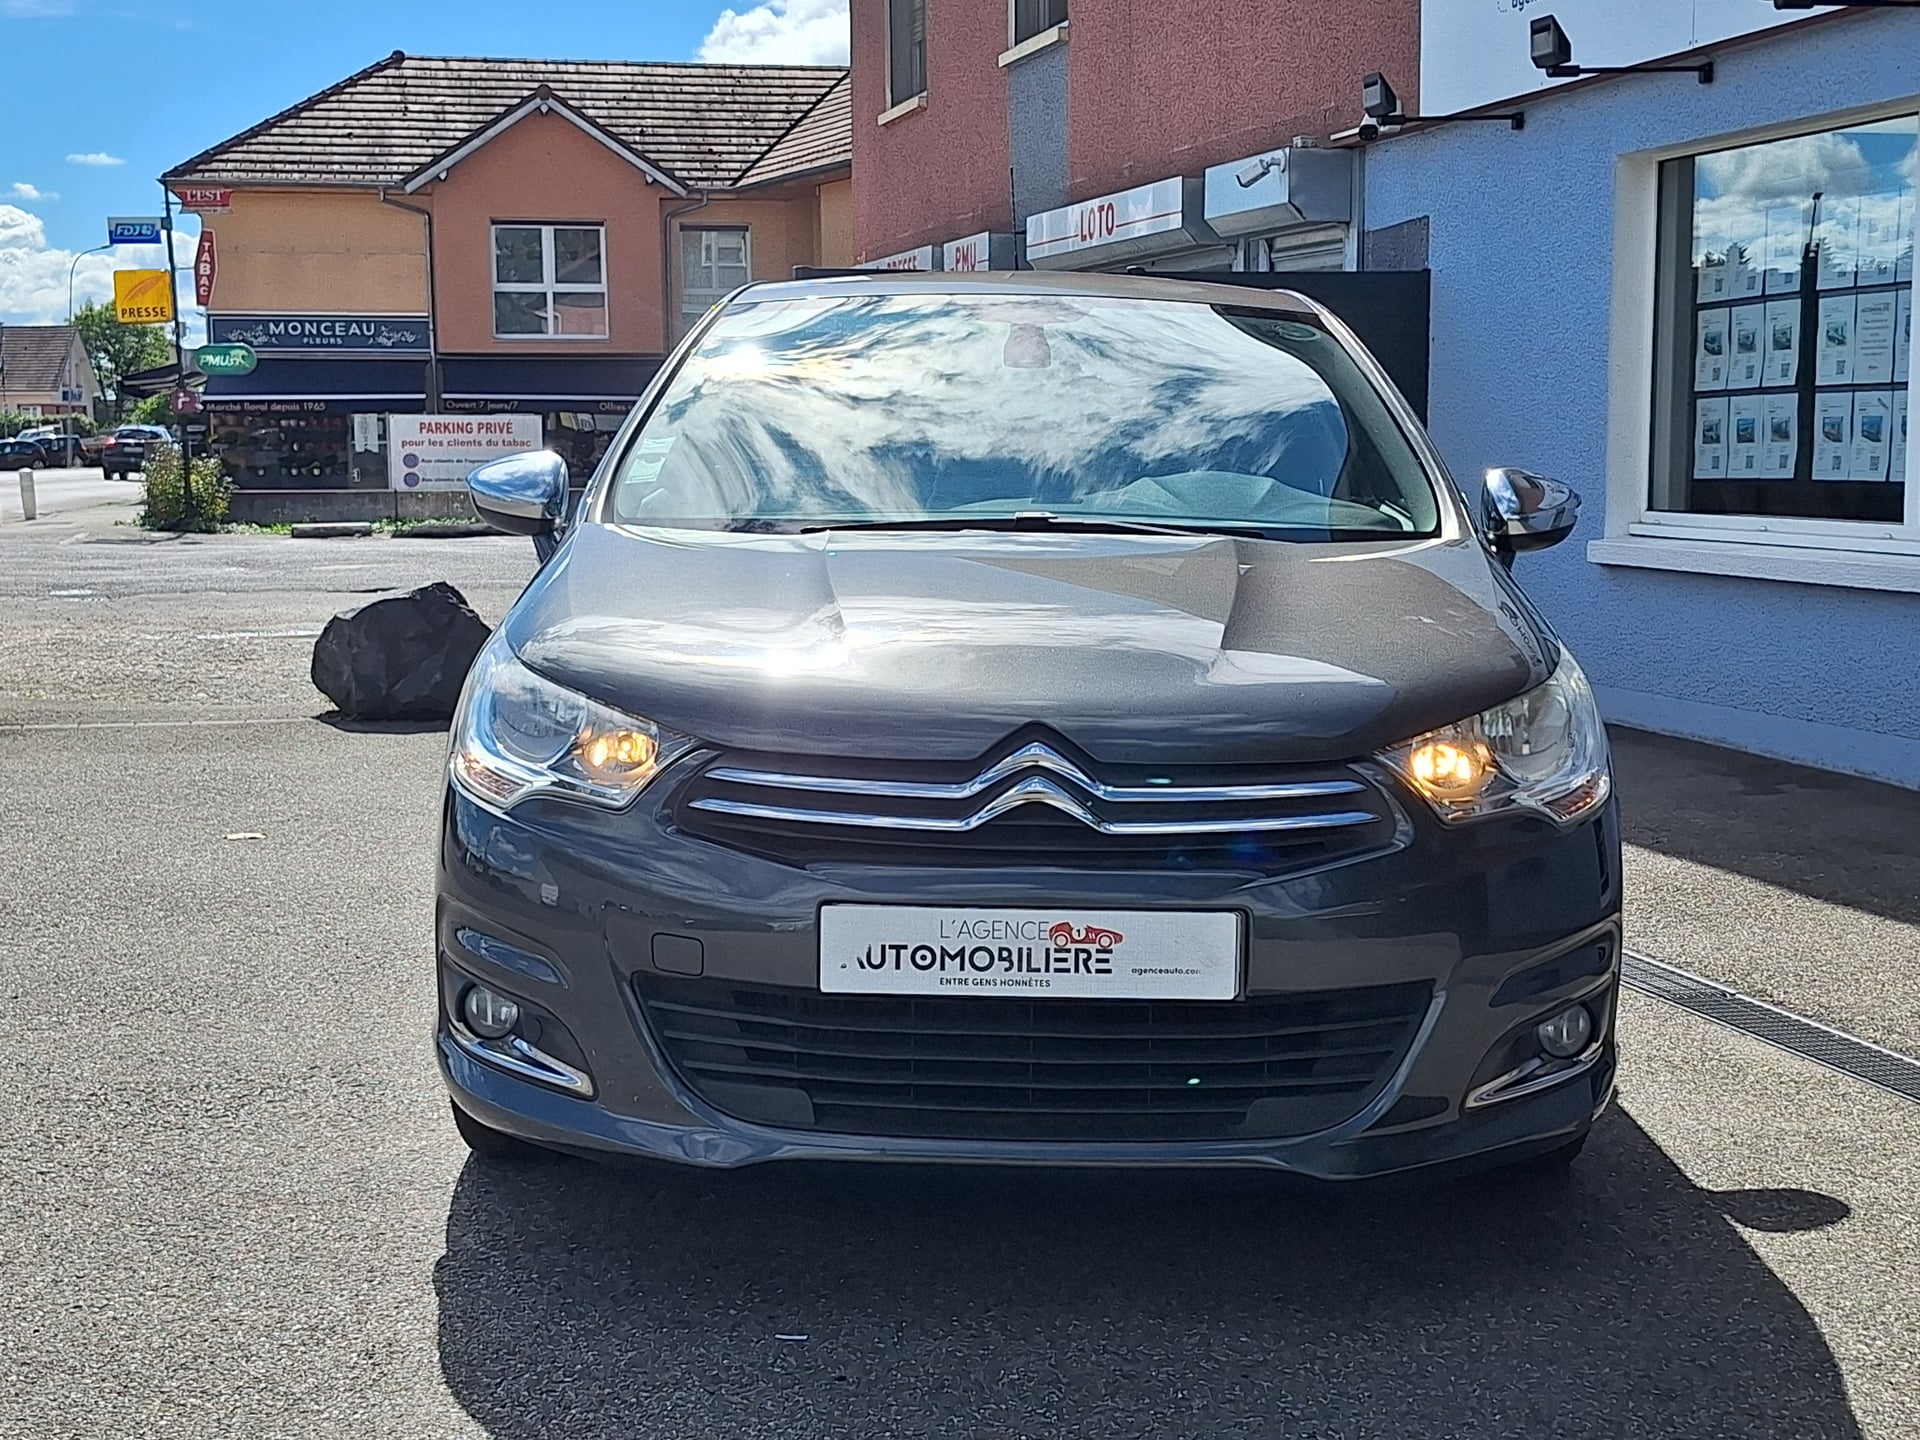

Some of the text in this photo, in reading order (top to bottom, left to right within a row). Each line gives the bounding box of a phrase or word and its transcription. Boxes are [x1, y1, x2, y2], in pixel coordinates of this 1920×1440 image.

[1079, 202, 1115, 242] LOTO
[116, 225, 140, 236] FDJ
[955, 241, 977, 271] PMU
[199, 242, 212, 296] TABAC
[121, 306, 167, 318] PRESSE
[269, 321, 375, 336] MONCEAU
[303, 337, 343, 345] FLEURS
[199, 354, 230, 367] PMU
[206, 402, 241, 411] Marché
[270, 402, 300, 412] depuis
[478, 401, 485, 409] 7
[419, 419, 514, 434] PARKING PRIVÉ
[401, 438, 532, 449] pour les clients du tabac
[939, 919, 1049, 941] L'AGENCE
[1075, 928, 1082, 938] 1
[939, 976, 1051, 988] ENTRE GENS HONNÊTES
